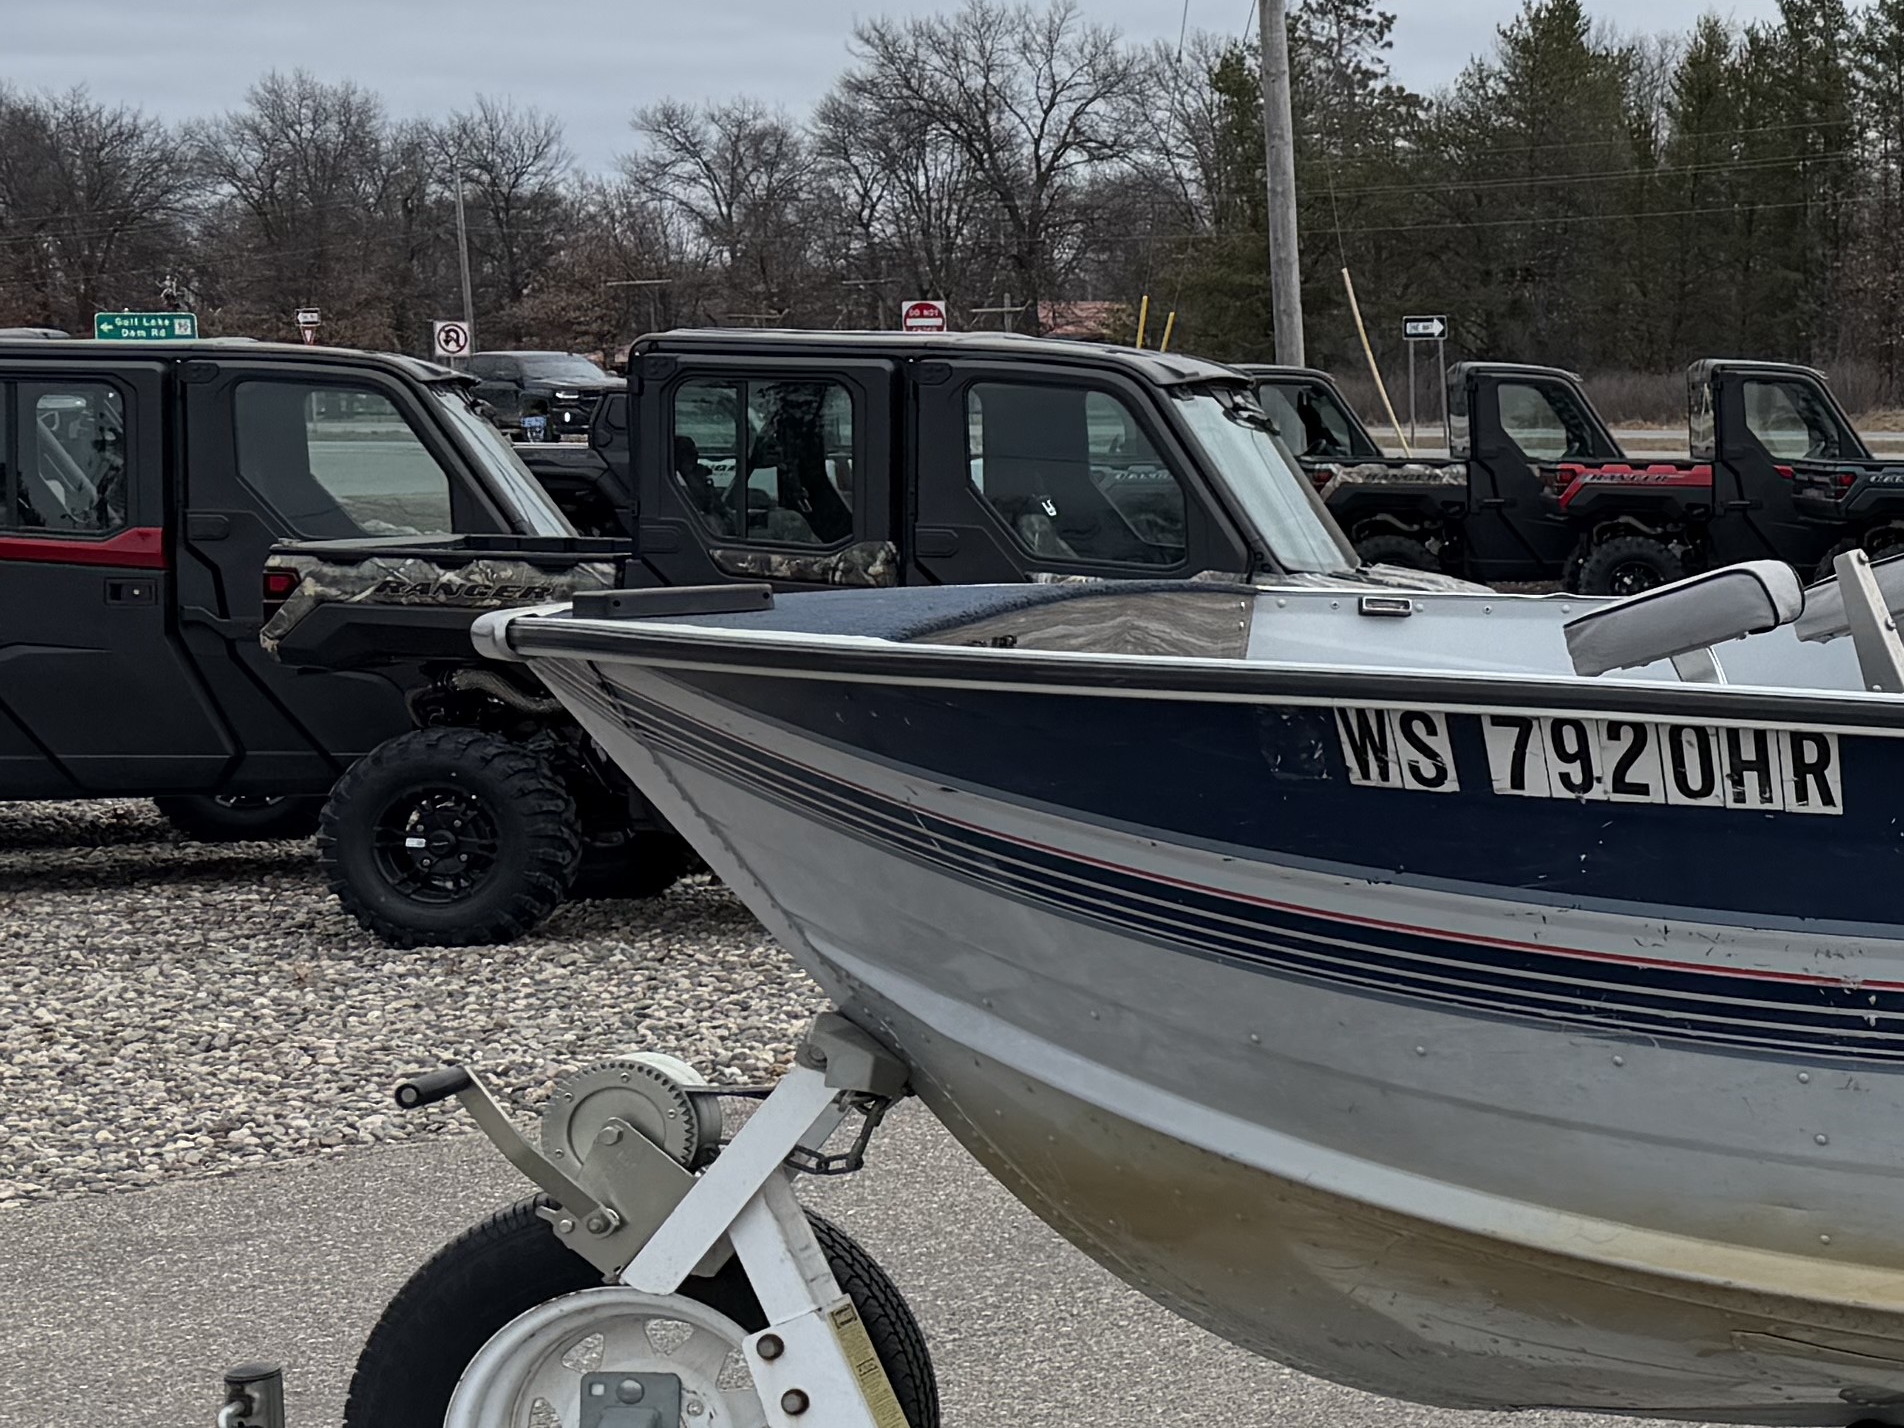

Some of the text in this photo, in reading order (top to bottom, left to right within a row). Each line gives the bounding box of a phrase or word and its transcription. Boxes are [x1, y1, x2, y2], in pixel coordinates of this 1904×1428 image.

[142, 317, 170, 326] Lake
[121, 328, 166, 337] Dam Rd
[373, 579, 552, 599] RANGER
[1336, 706, 1837, 807] WS 7920HR
